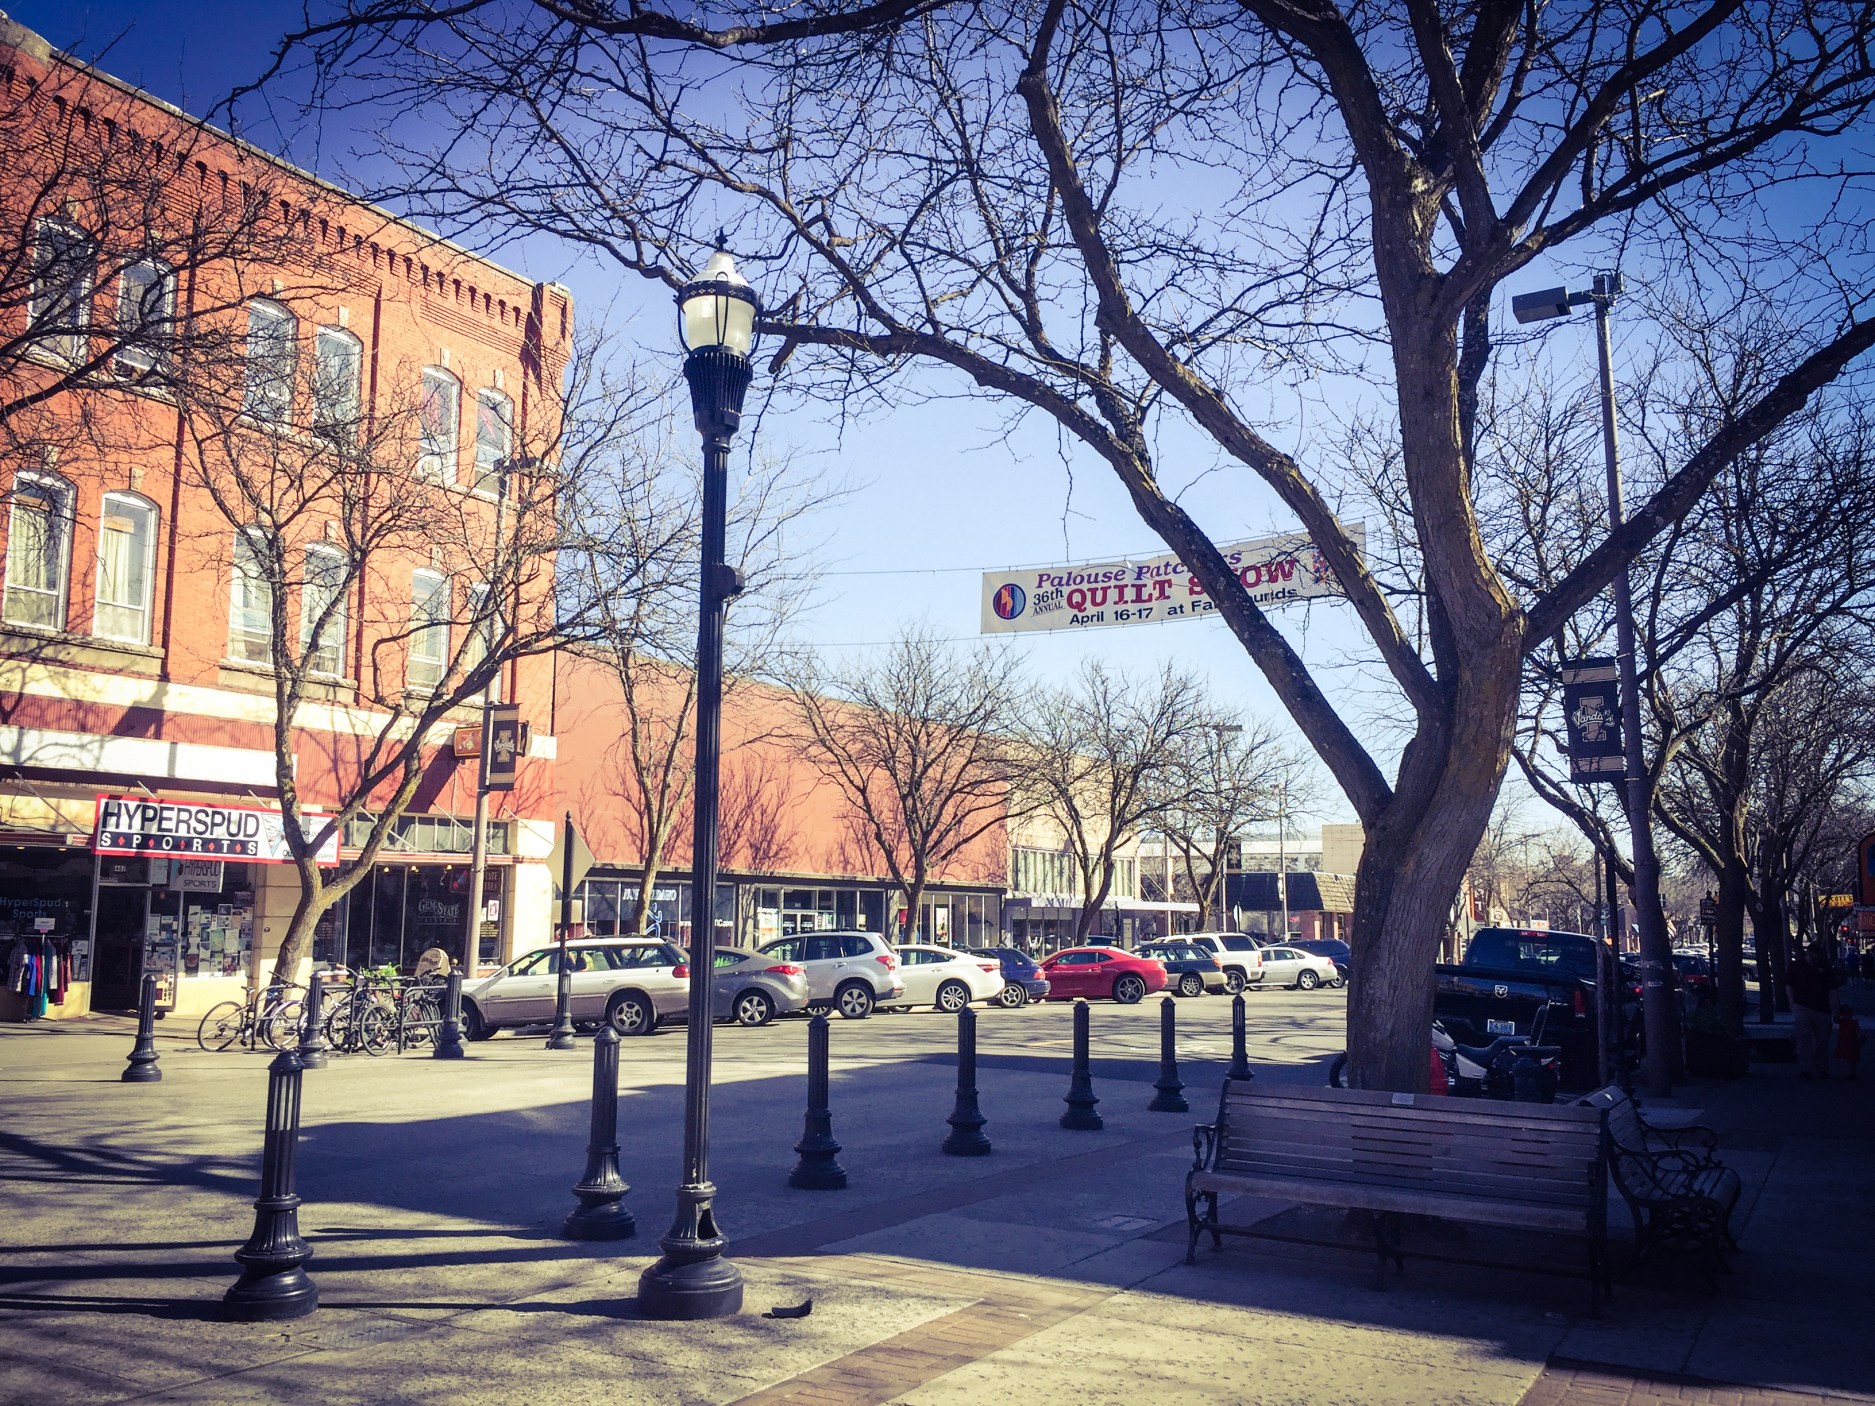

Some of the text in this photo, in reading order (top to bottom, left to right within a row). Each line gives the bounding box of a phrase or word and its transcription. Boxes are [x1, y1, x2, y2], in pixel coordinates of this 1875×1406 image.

[1035, 552, 1242, 589] Palouse Patcs
[1032, 587, 1065, 606] 36th
[1066, 558, 1298, 613] QUILT SOW
[1031, 602, 1064, 616] ANNUAL
[1069, 587, 1298, 626] April 16-17 at Faunds
[101, 801, 261, 839] HYPERSPUD
[183, 878, 218, 890] SPORTS
[12, 909, 48, 920] Sports
